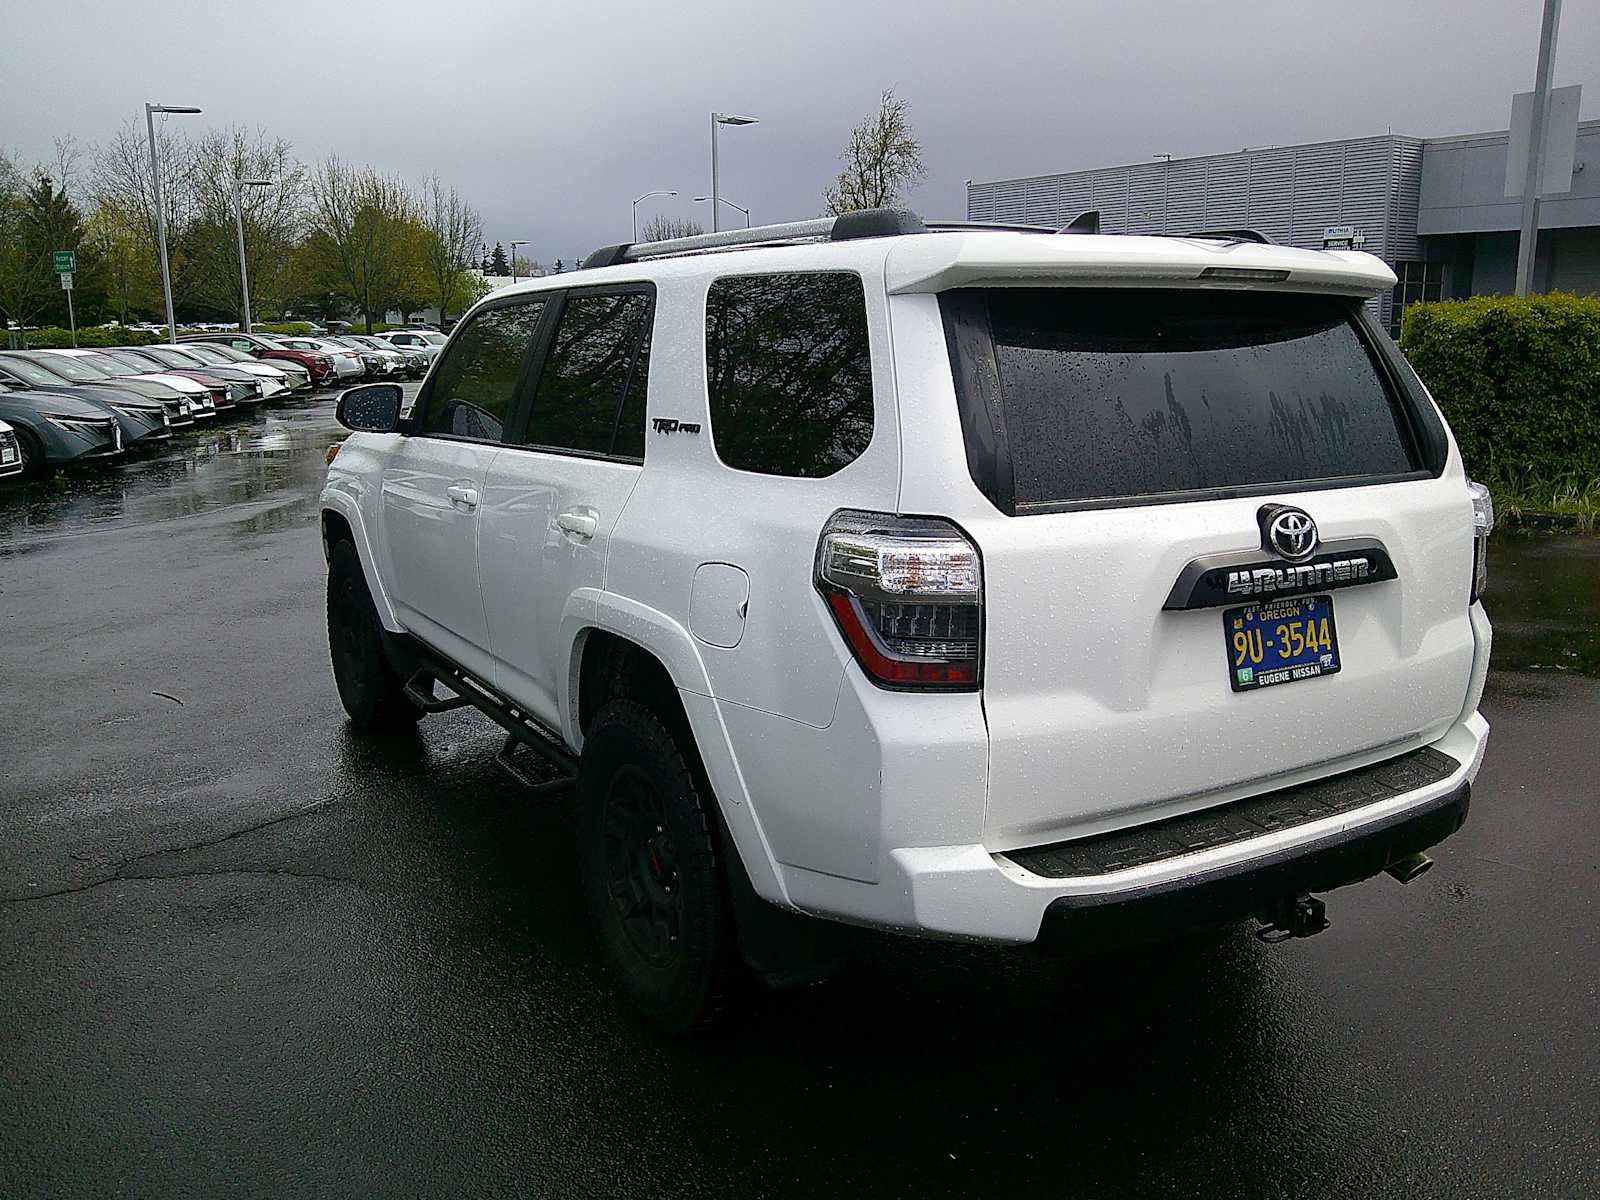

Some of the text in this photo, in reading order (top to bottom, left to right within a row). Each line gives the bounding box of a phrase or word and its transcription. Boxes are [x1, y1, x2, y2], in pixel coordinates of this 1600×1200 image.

[652, 418, 679, 435] TRD
[1260, 607, 1300, 621] OREGON
[1233, 618, 1332, 666] 9U-3544
[1242, 670, 1249, 681] 6
[1258, 671, 1291, 686] EUGENE
[1292, 664, 1321, 679] NISSAN
